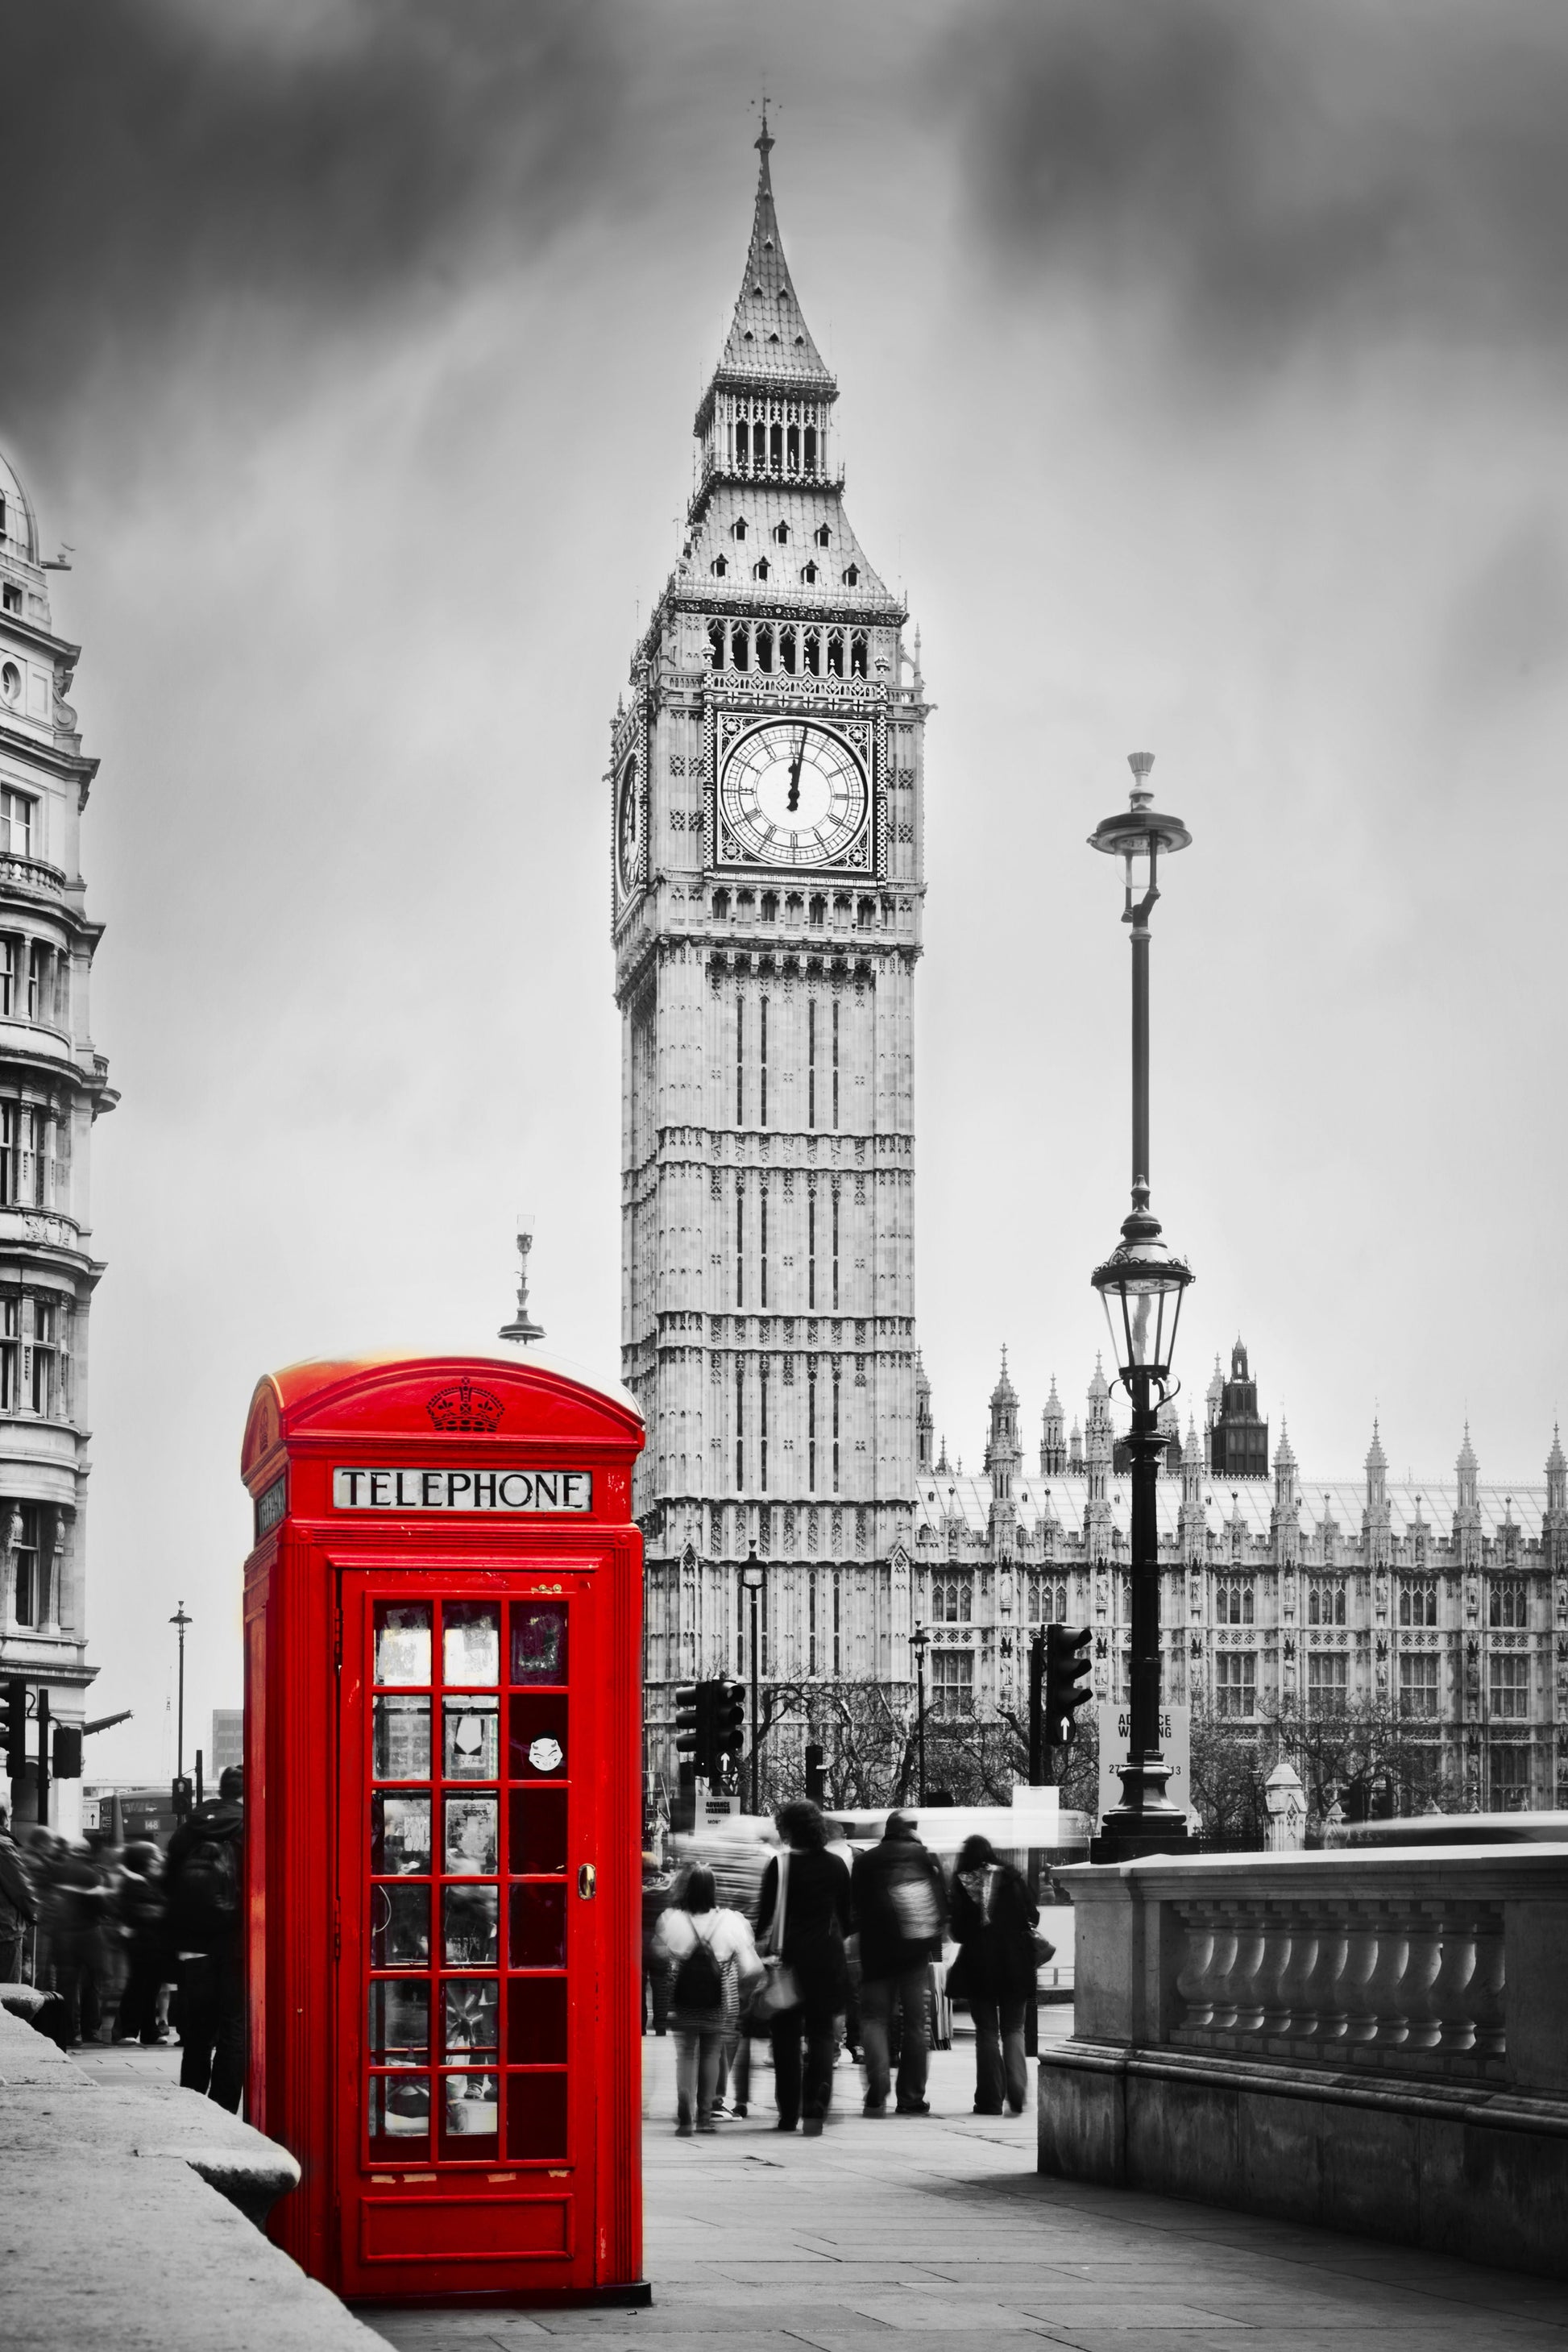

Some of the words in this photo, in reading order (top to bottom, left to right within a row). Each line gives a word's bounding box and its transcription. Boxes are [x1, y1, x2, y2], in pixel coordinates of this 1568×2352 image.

[342, 1471, 583, 1508] TELEPHONE
[1118, 1714, 1171, 1726] ADCE
[145, 1820, 159, 1830] 148
